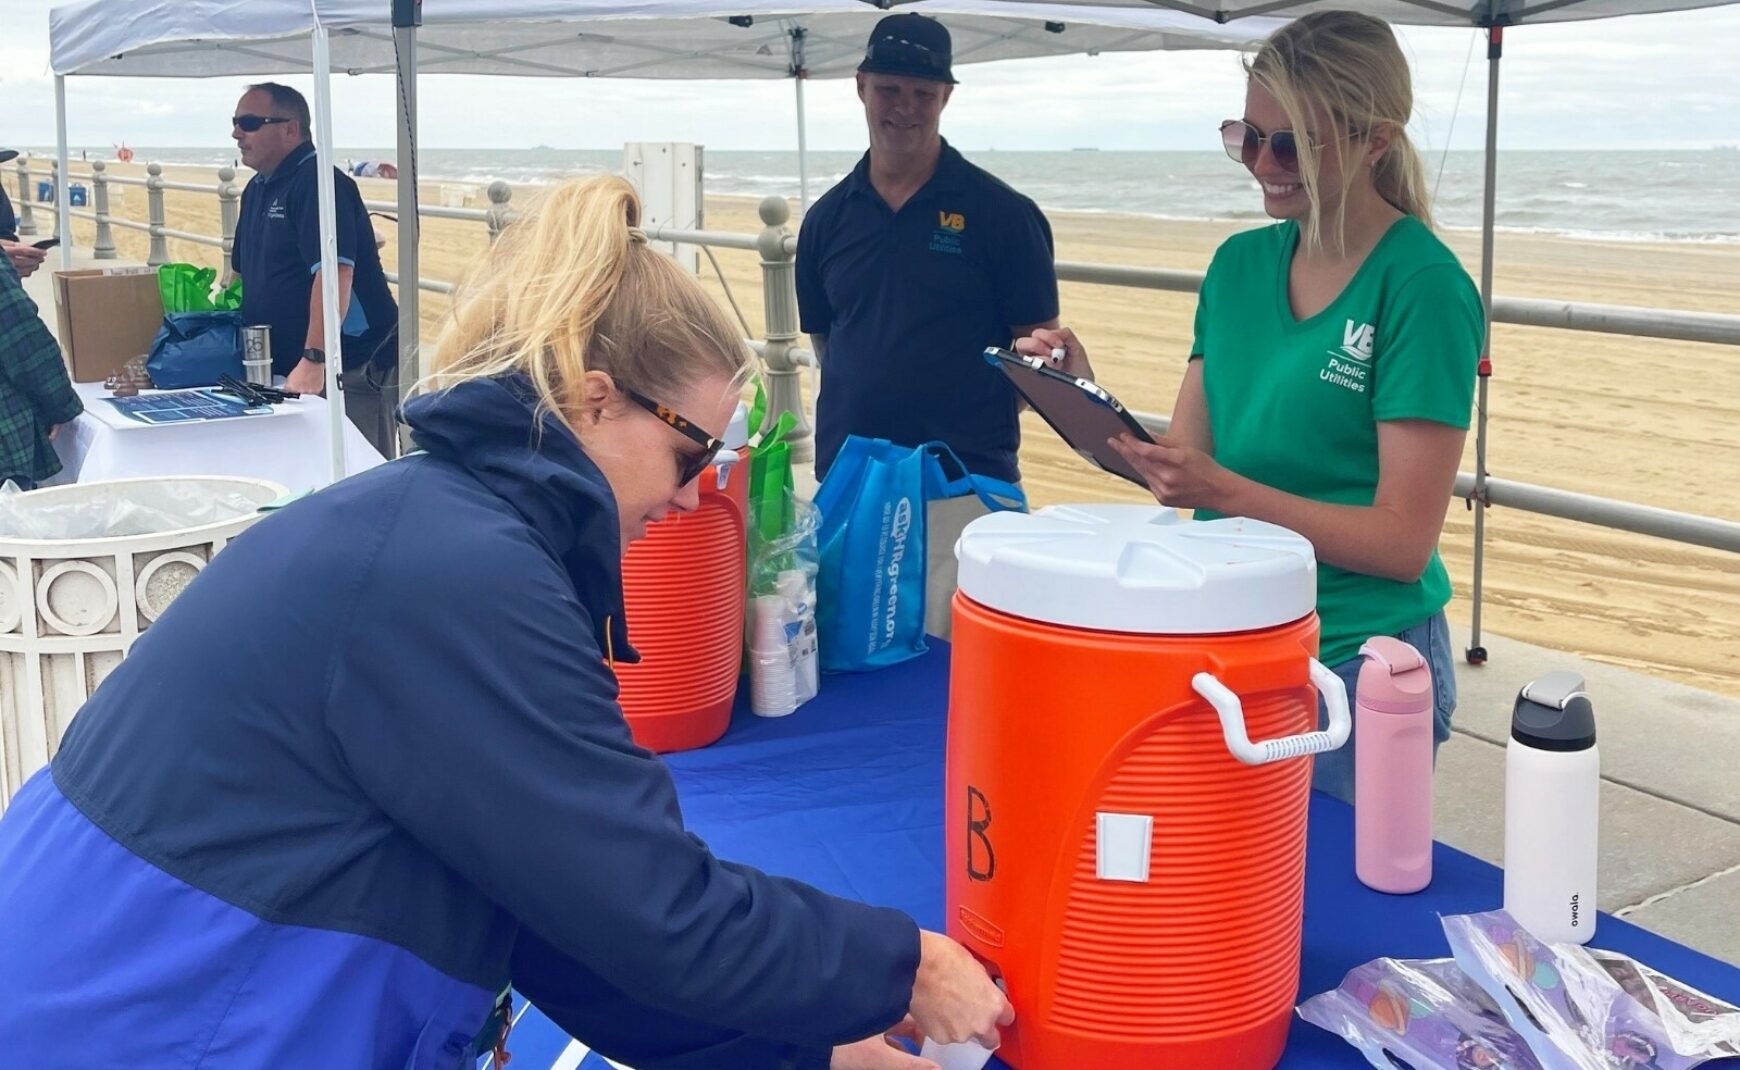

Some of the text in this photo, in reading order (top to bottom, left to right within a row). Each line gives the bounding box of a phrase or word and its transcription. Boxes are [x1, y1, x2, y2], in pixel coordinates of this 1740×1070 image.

[940, 211, 965, 230] VB
[246, 336, 263, 353] 25
[1343, 318, 1375, 355] VB
[1319, 368, 1366, 393] Utilities
[1328, 358, 1366, 380] Public
[967, 785, 995, 882] B
